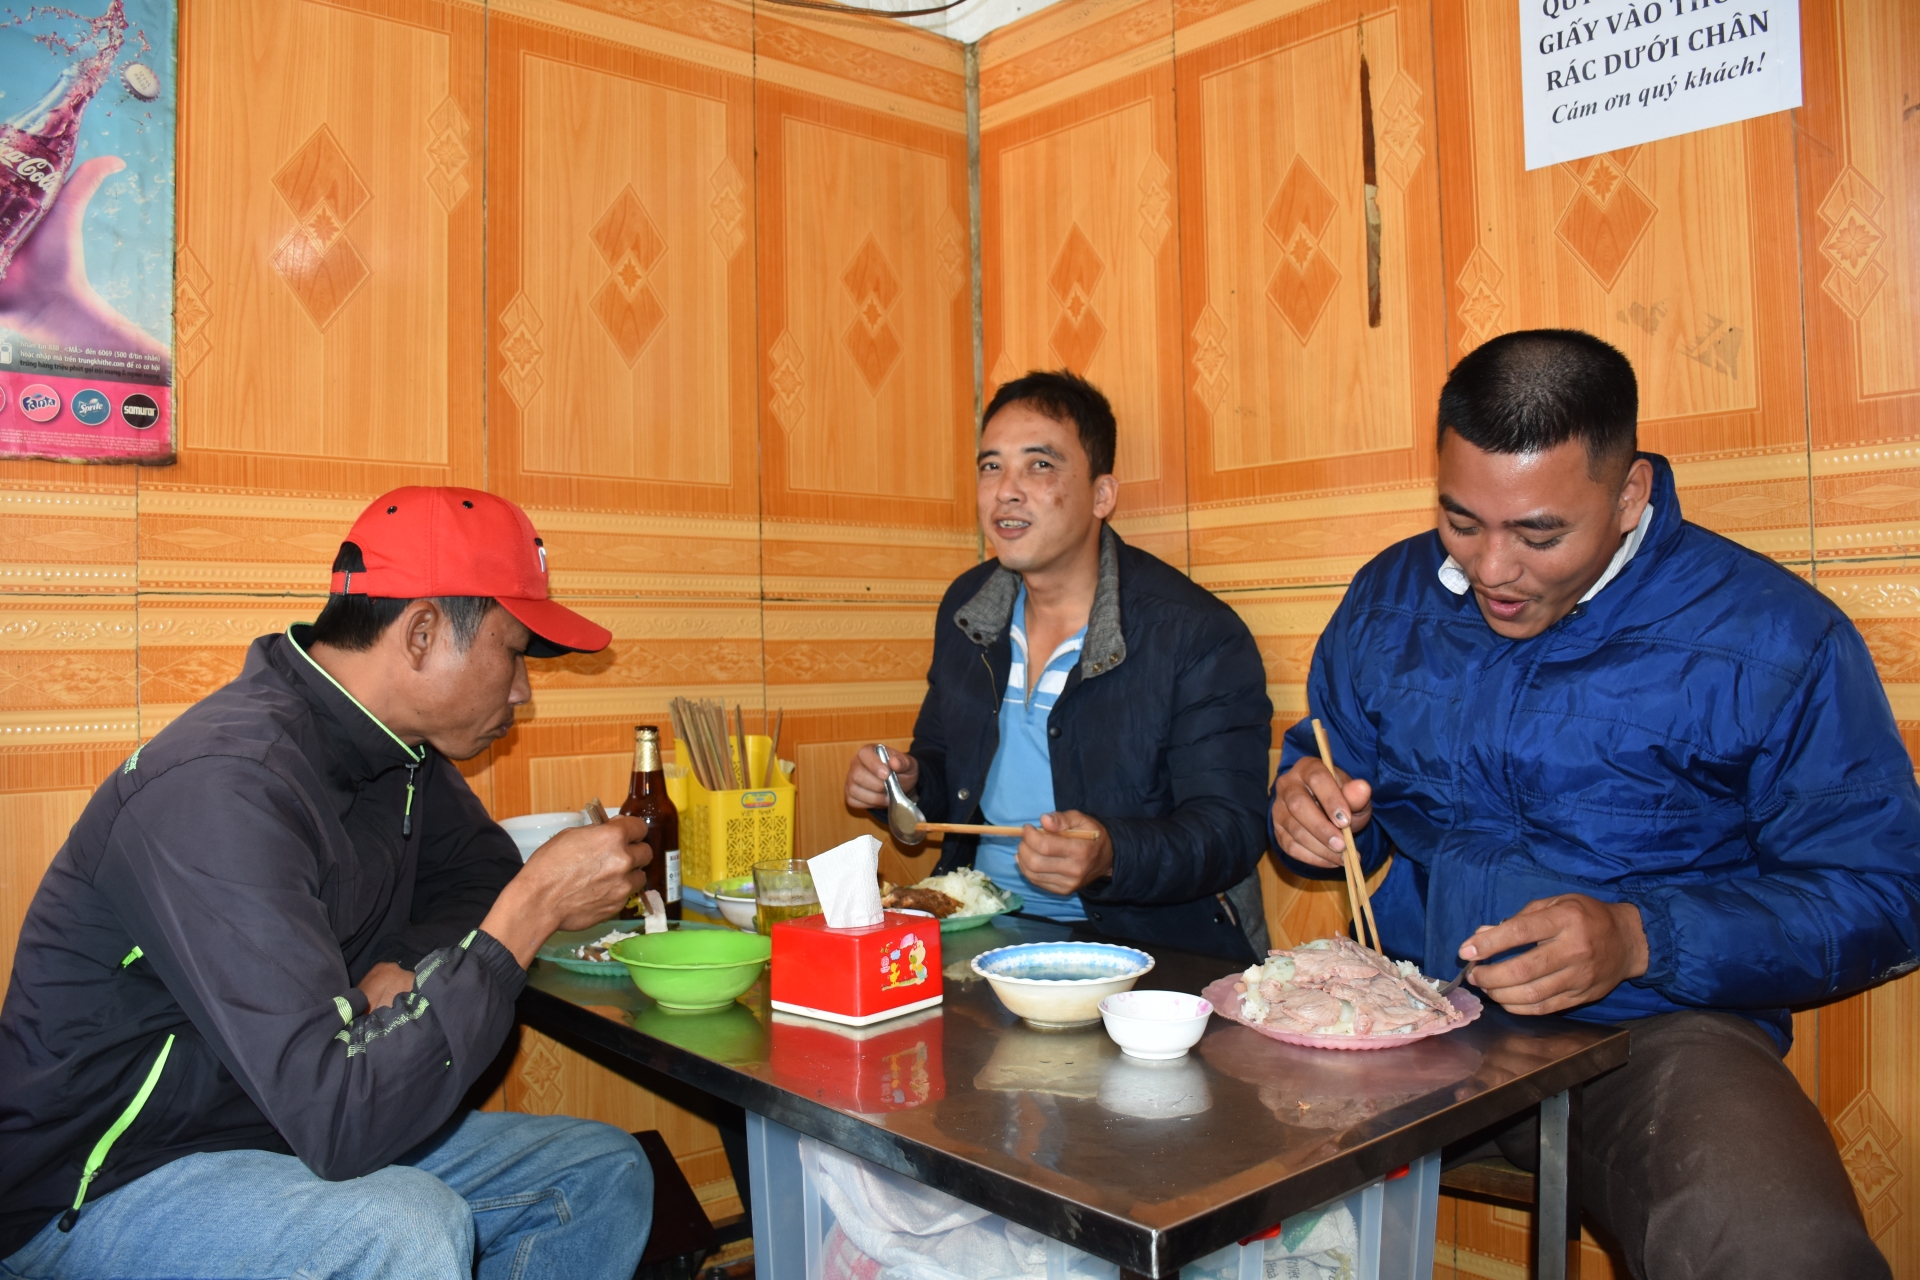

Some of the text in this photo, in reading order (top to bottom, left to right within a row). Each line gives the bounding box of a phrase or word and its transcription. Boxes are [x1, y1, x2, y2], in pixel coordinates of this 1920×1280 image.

[1542, 0, 1591, 19] QU
[1539, 17, 1599, 54] GIẤY
[1605, 3, 1662, 34] VÀO
[1547, 10, 1769, 92] RÁC DƯỚI CHÂN
[1552, 51, 1766, 124] Cám ơn quý khách!
[22, 396, 56, 411] Fanta
[79, 402, 104, 414] Sprite
